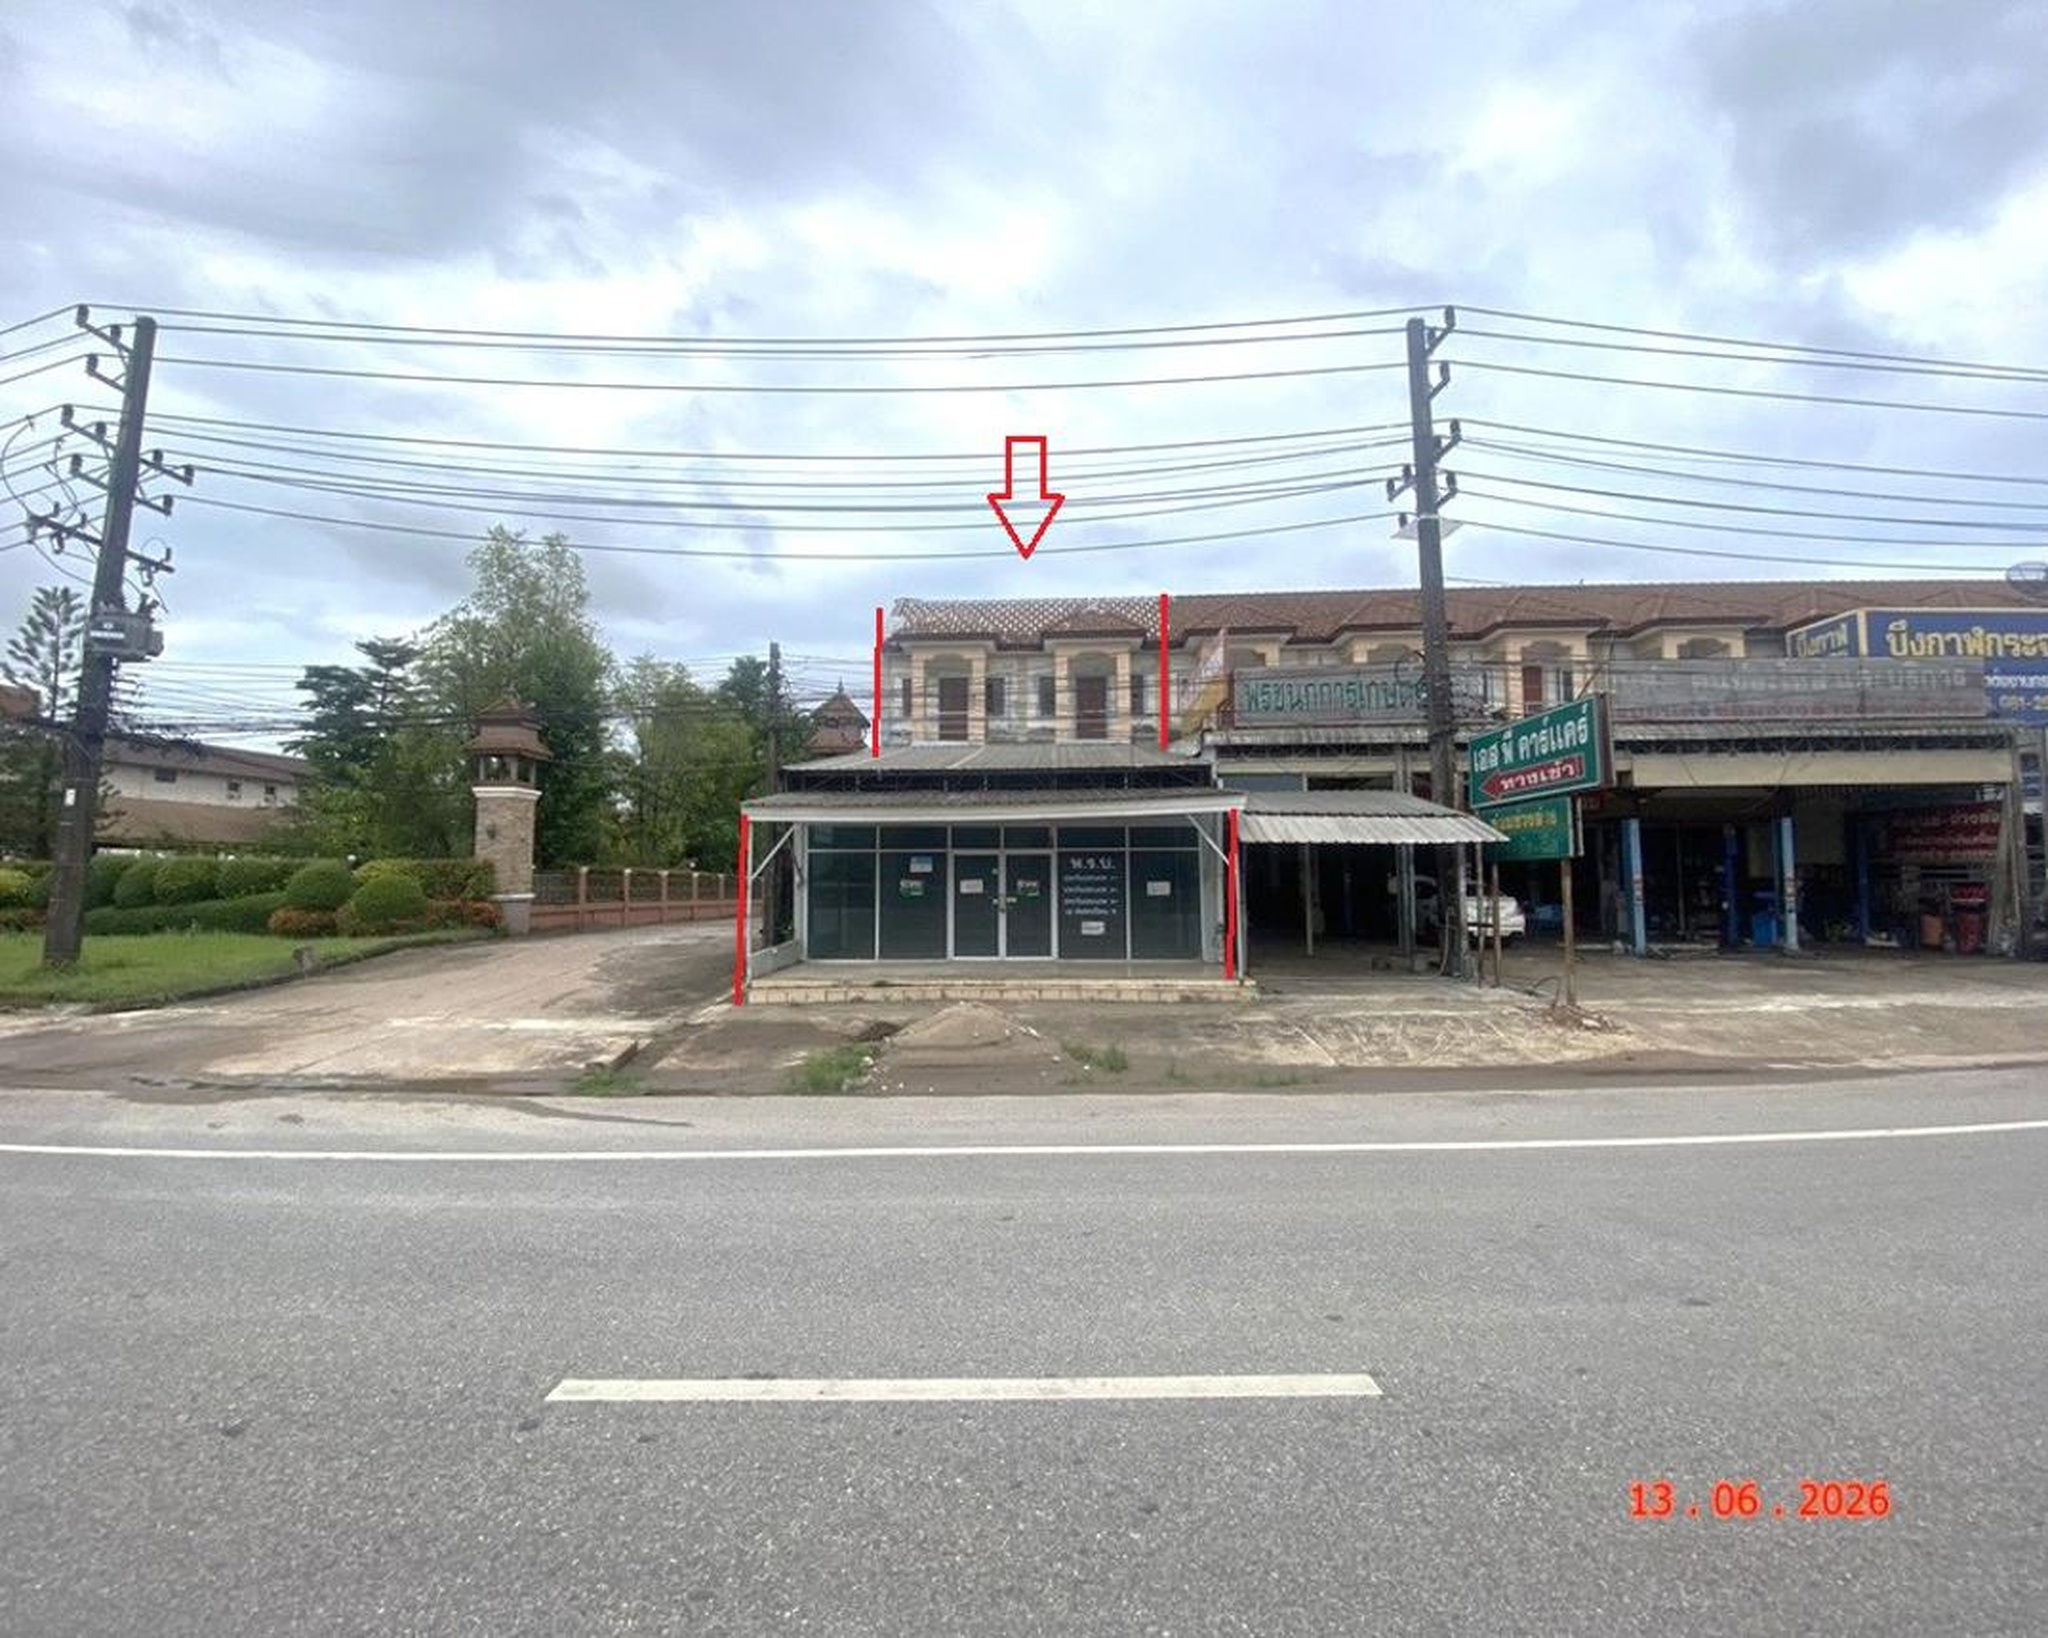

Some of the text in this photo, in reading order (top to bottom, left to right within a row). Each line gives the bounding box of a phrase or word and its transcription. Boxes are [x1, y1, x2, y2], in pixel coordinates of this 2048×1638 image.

[1473, 743, 1499, 773] เอส
[1517, 702, 1589, 760] คาร์แคร์
[1500, 760, 1576, 790] ทางเข้า
